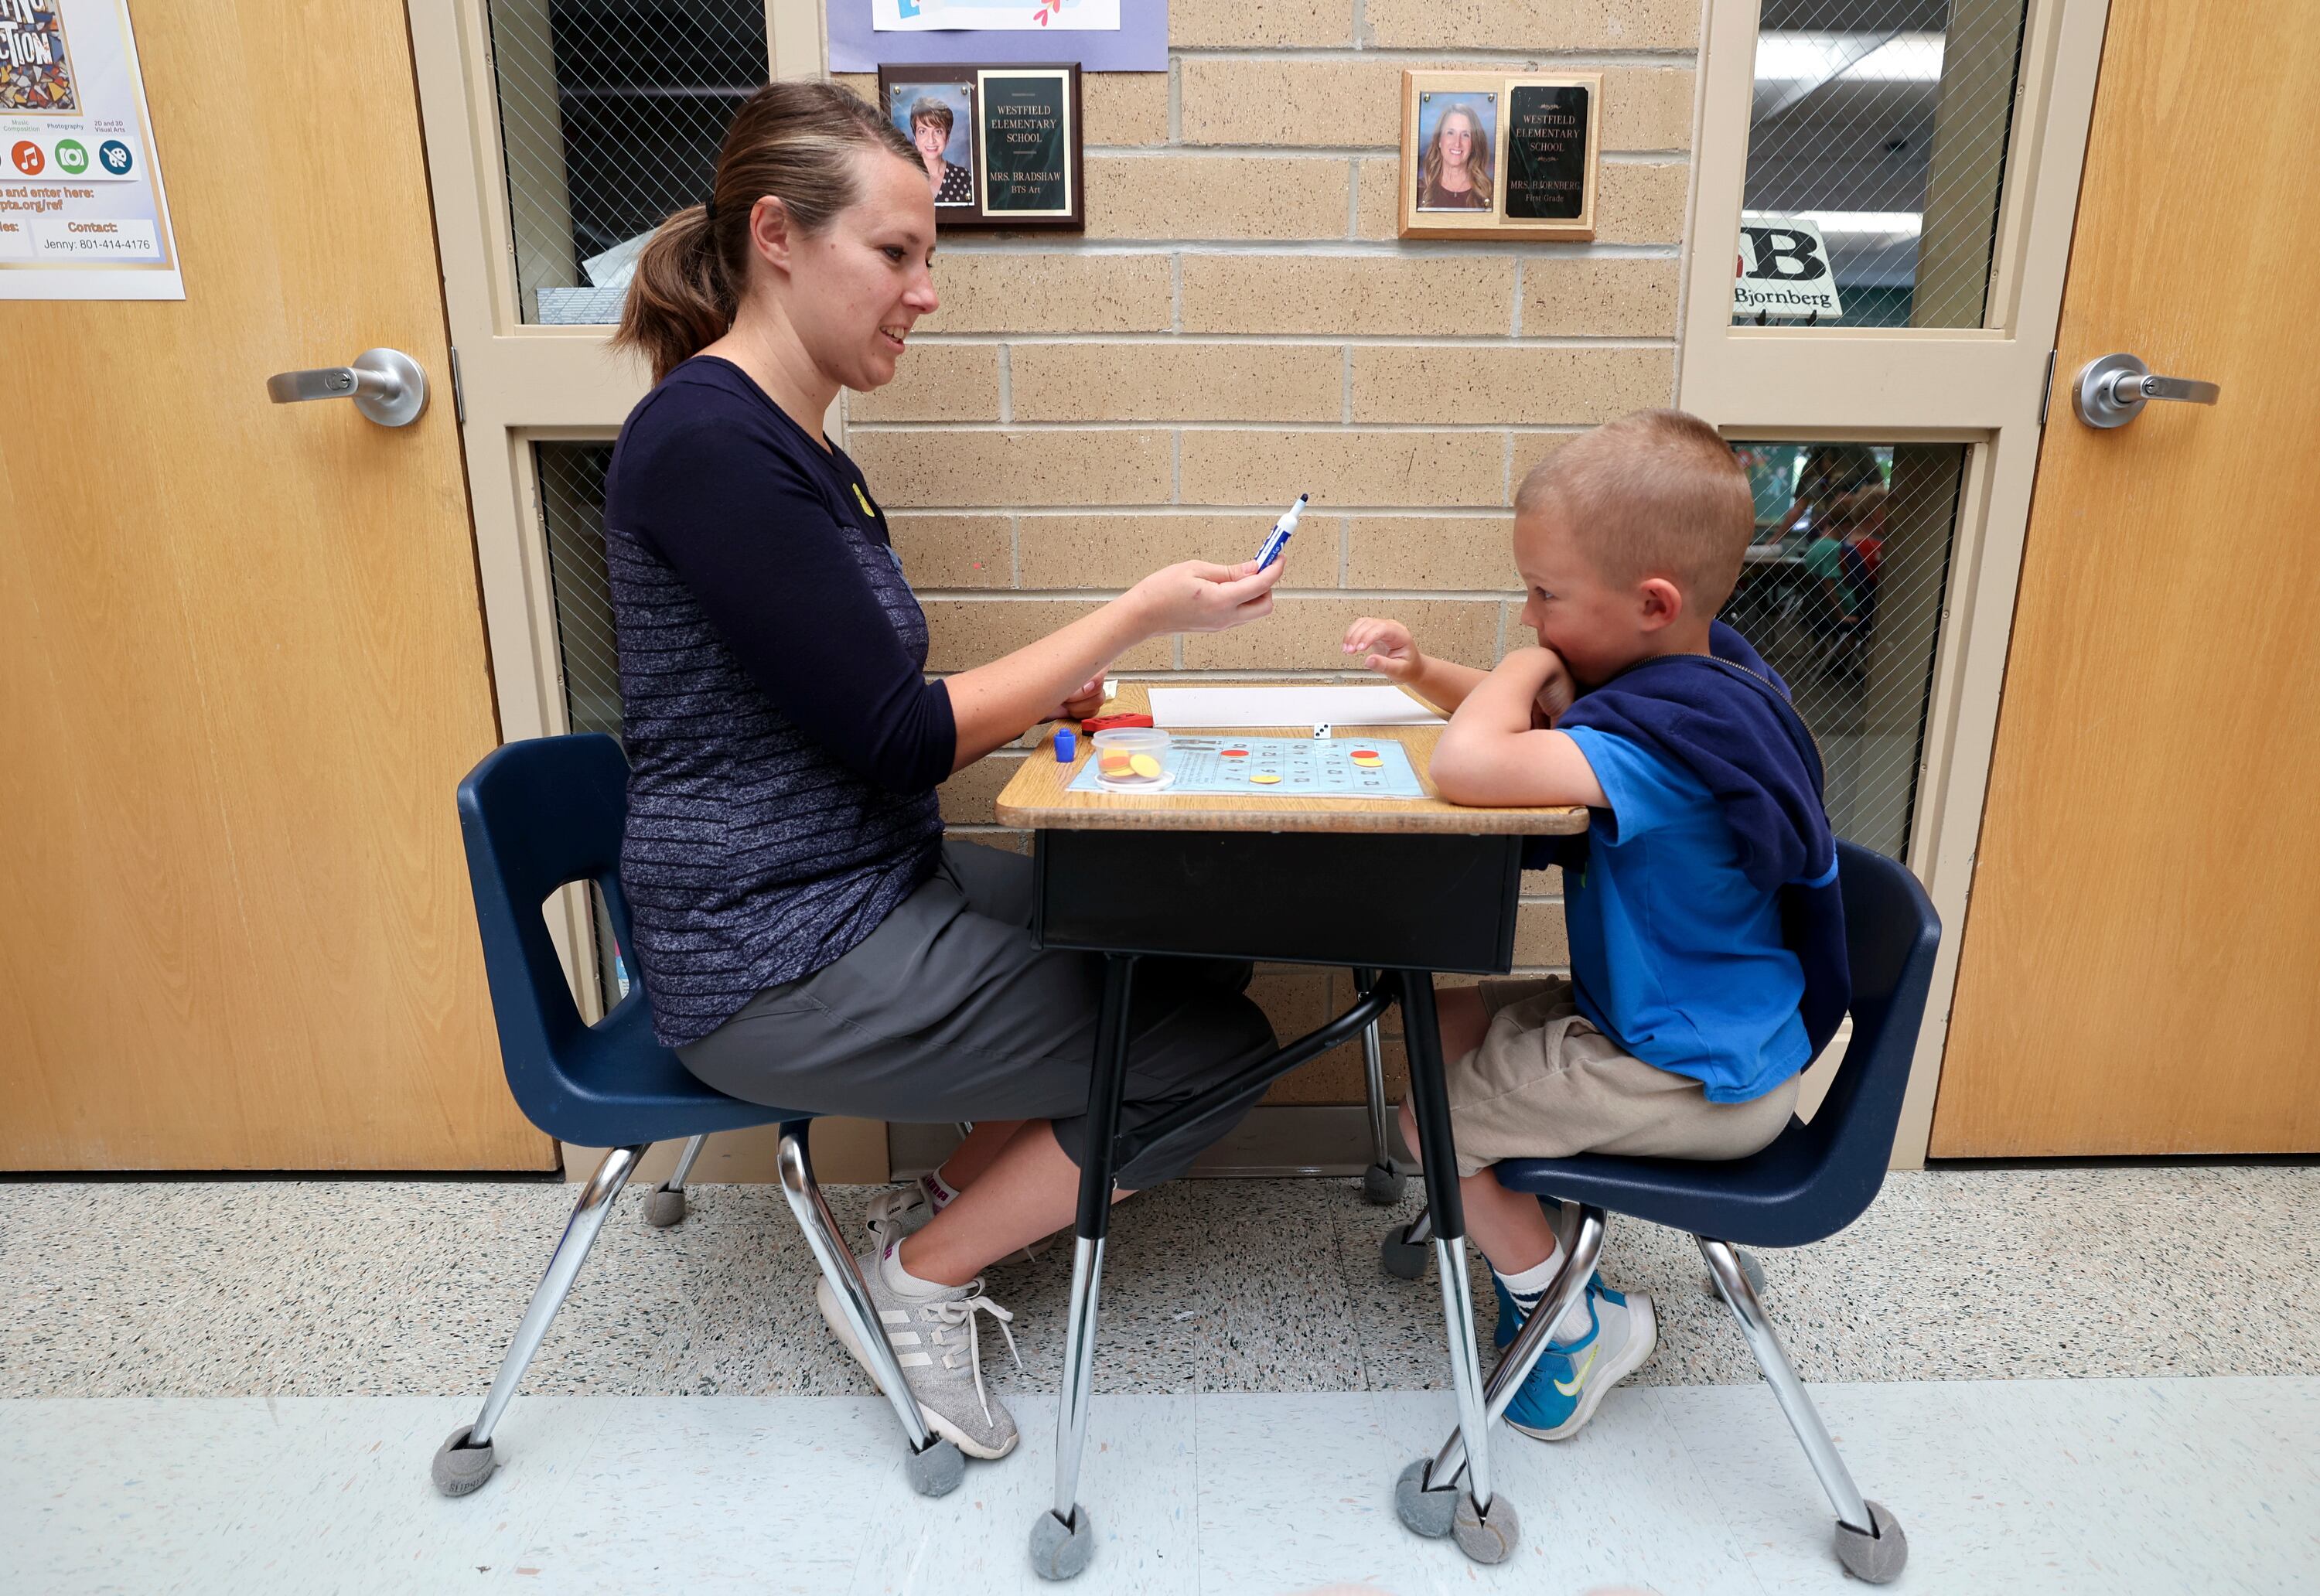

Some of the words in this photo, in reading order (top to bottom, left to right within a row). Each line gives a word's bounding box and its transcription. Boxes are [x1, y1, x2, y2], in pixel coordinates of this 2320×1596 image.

[997, 104, 1051, 115] WESTFIELD
[991, 118, 1057, 129] ELEMENTARY
[1523, 114, 1575, 124] WESTFIELD
[1006, 133, 1042, 143] SCHOOL
[1516, 128, 1580, 138] ELEMENTARY
[1530, 142, 1565, 152] SCHOOL
[990, 172, 1010, 181] MRS.
[1013, 172, 1061, 181] BRADSHAW
[1012, 185, 1026, 193] BTS
[1510, 180, 1530, 189] MRS.
[5, 186, 28, 198] and
[30, 188, 62, 198] enter
[63, 186, 94, 199] here:
[1526, 193, 1541, 202] First
[44, 239, 78, 251] Jenny:
[80, 239, 151, 250] 801-414-4176
[1740, 227, 1827, 281] B
[1734, 288, 1832, 309] Bjornberg
